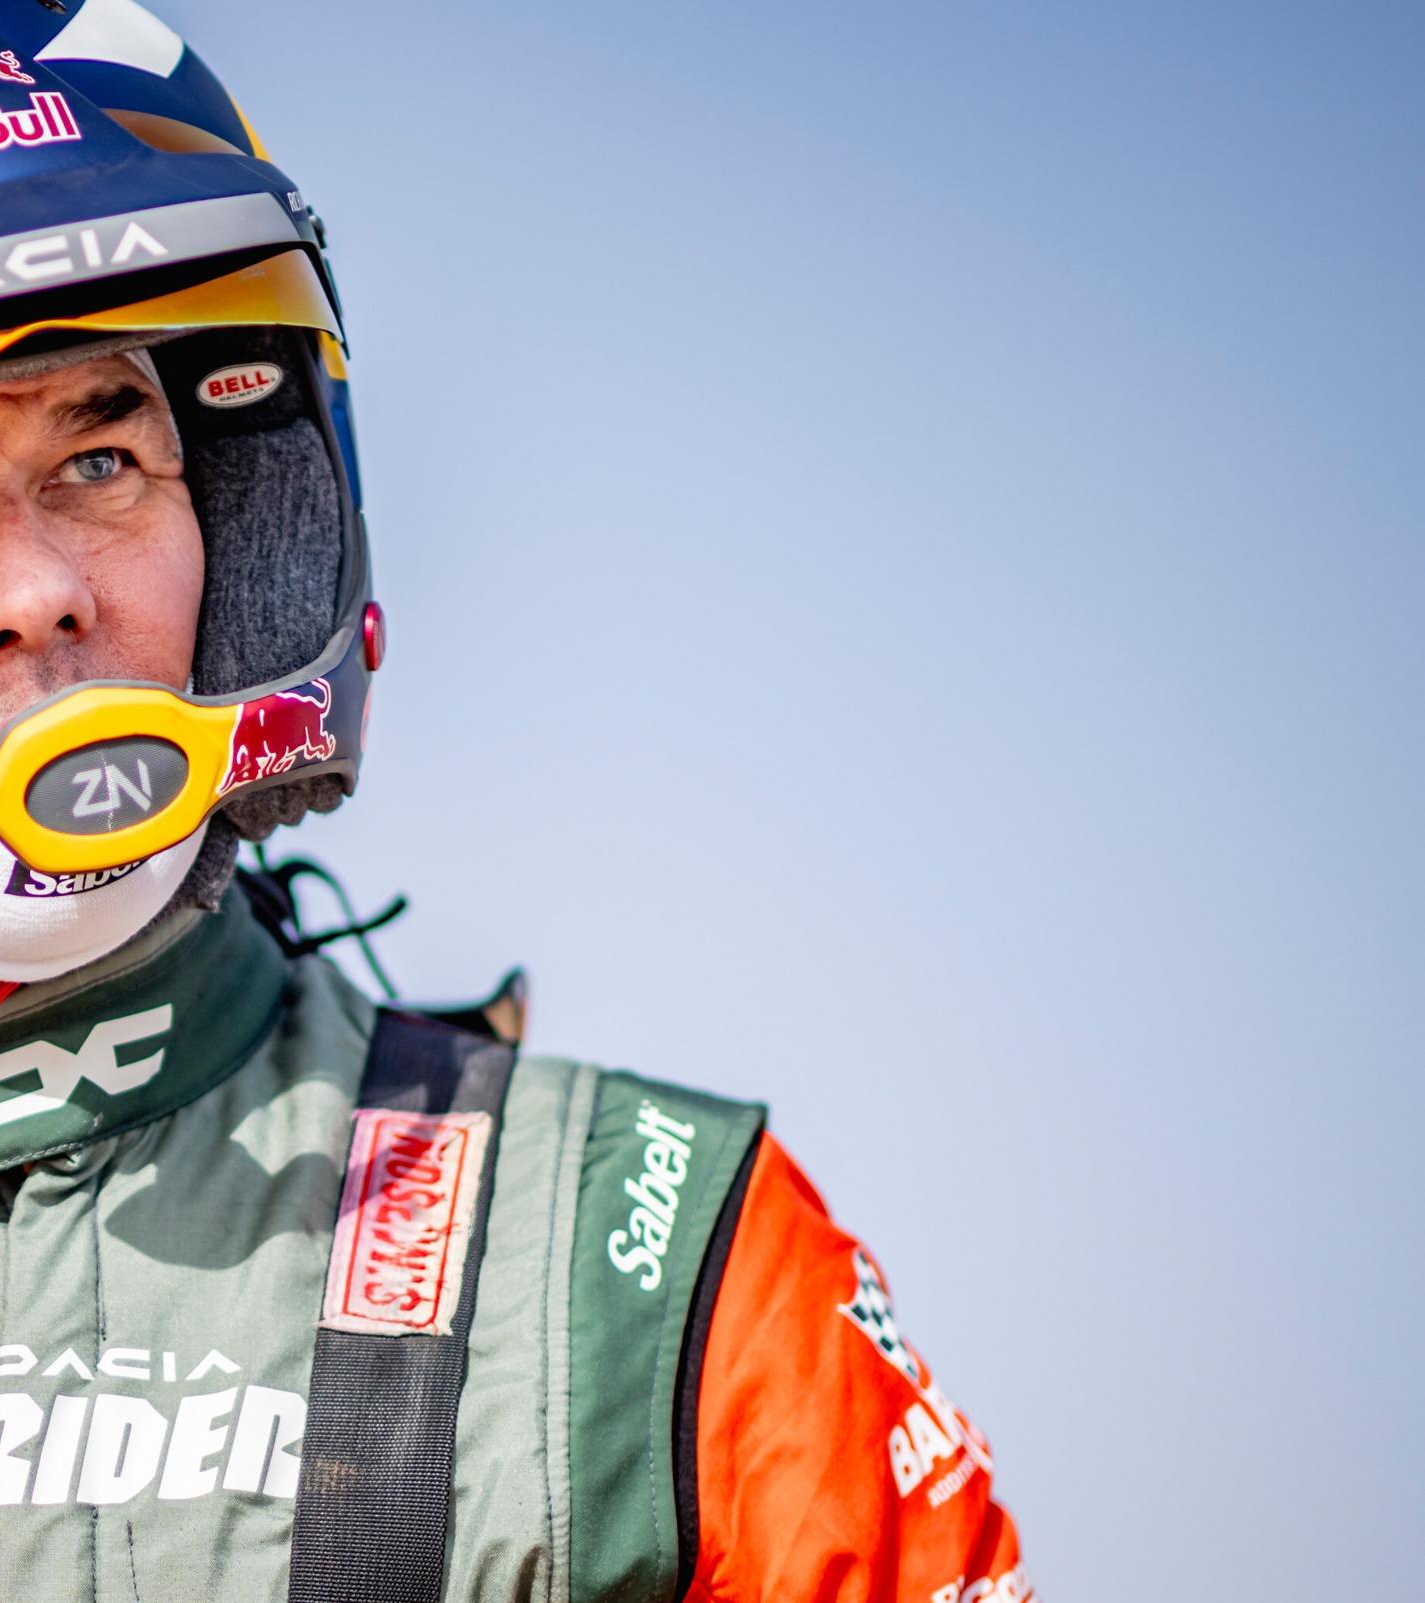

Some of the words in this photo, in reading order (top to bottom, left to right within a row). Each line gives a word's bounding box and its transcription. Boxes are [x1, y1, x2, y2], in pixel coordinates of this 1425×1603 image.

[207, 369, 270, 398] BELL
[71, 758, 152, 818] ZN
[607, 1105, 696, 1292] Sabelt
